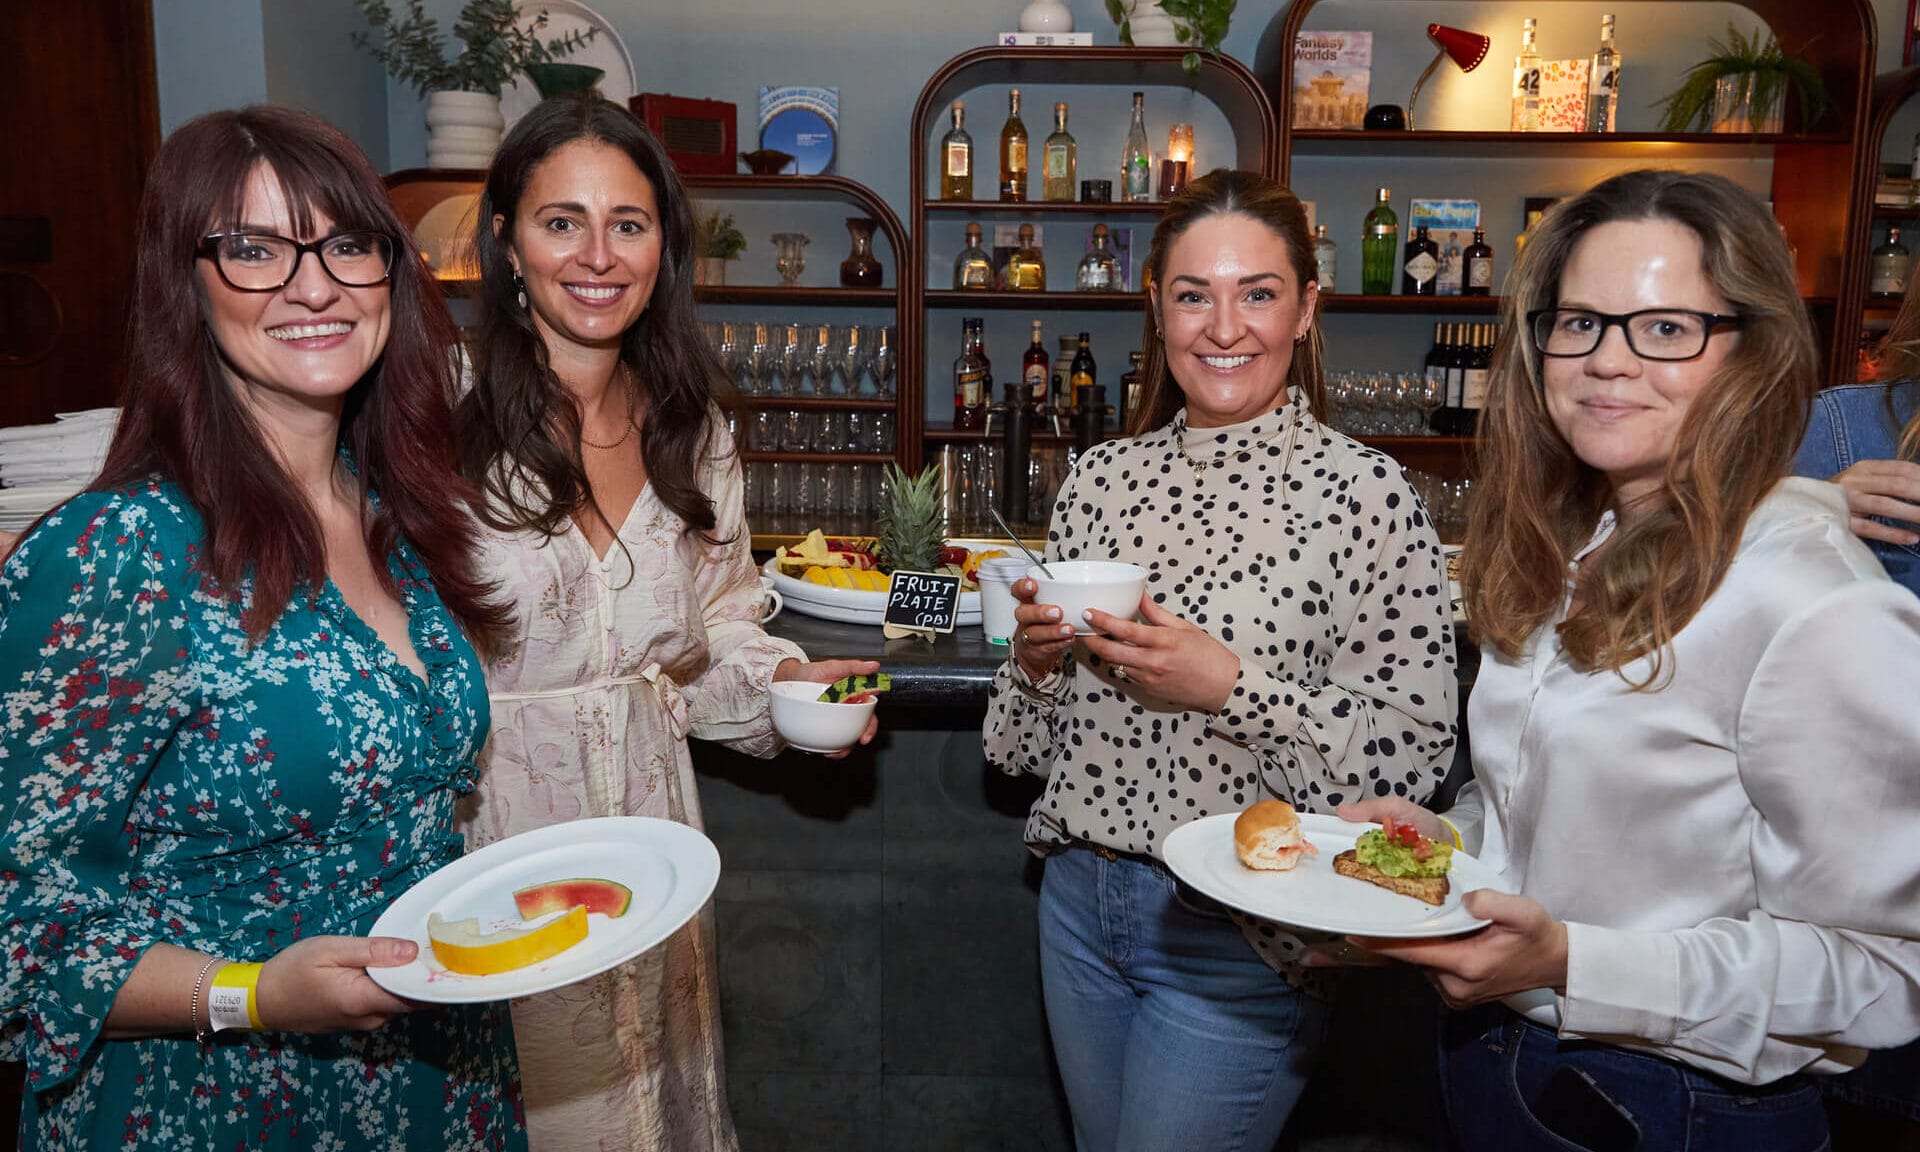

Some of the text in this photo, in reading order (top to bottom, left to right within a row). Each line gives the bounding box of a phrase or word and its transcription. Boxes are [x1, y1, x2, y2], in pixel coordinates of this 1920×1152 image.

[1295, 36, 1344, 51] Fantasy
[1518, 69, 1540, 90] 42
[895, 575, 955, 595] FRUIT
[889, 592, 949, 611] PLATE
[915, 612, 949, 628] (PB)
